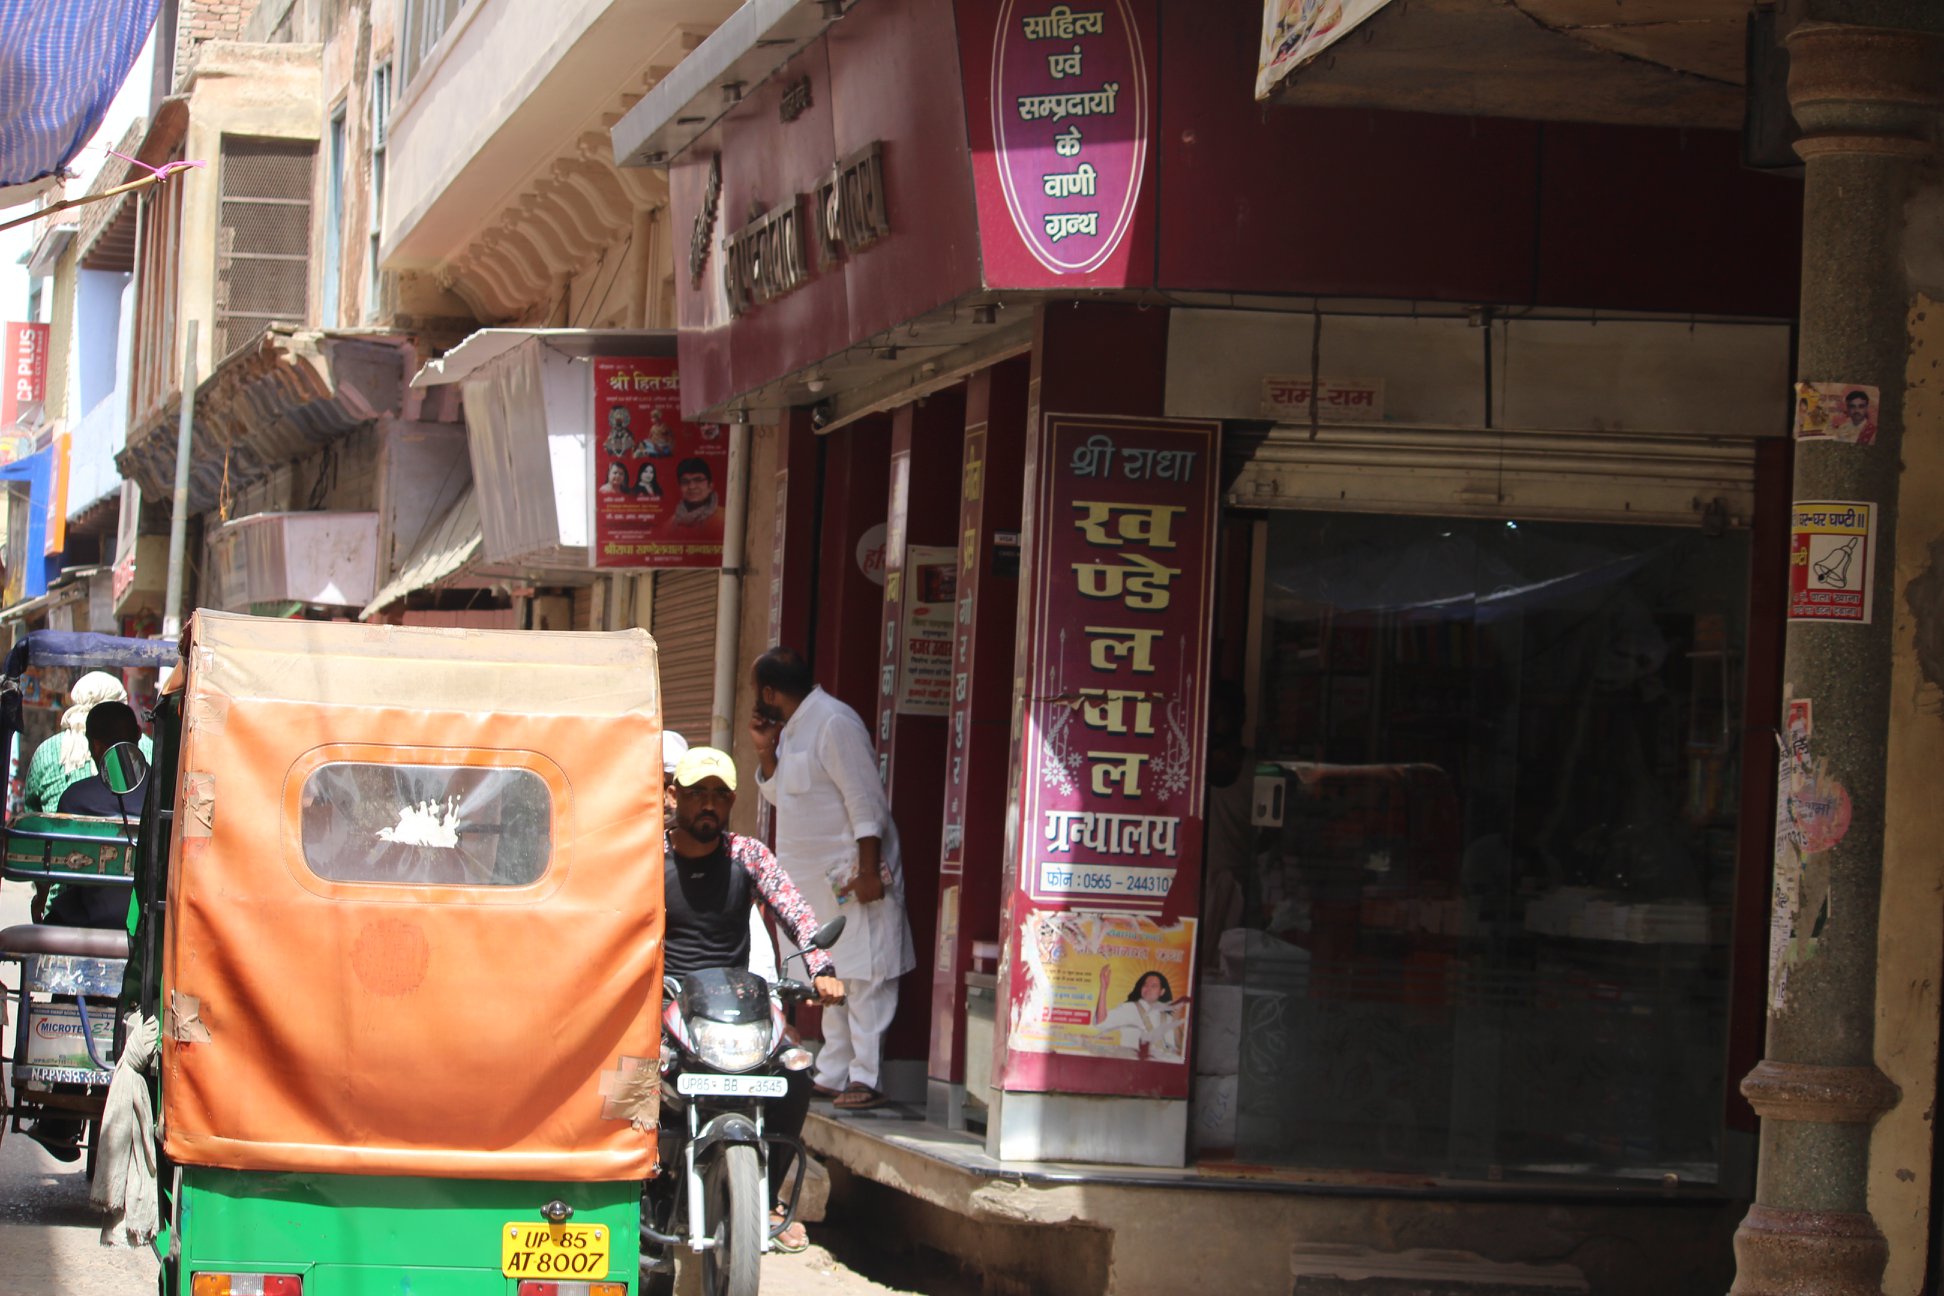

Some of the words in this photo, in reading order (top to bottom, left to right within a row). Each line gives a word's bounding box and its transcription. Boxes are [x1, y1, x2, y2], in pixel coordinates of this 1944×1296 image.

[1022, 5, 1104, 40] साहित्य
[1048, 44, 1082, 79] एवं
[1017, 82, 1120, 122] सम्प्रदायों
[1054, 125, 1082, 157] के
[1042, 163, 1098, 198] वाणी
[1043, 211, 1099, 243] ग्रन्थ
[17, 328, 37, 376] PLUS
[16, 378, 33, 402] CP
[1070, 434, 1116, 478] श्री
[1121, 446, 1197, 482] राधा
[1044, 809, 1181, 857] ग्रन्थालय
[1083, 875, 1112, 890] 0565
